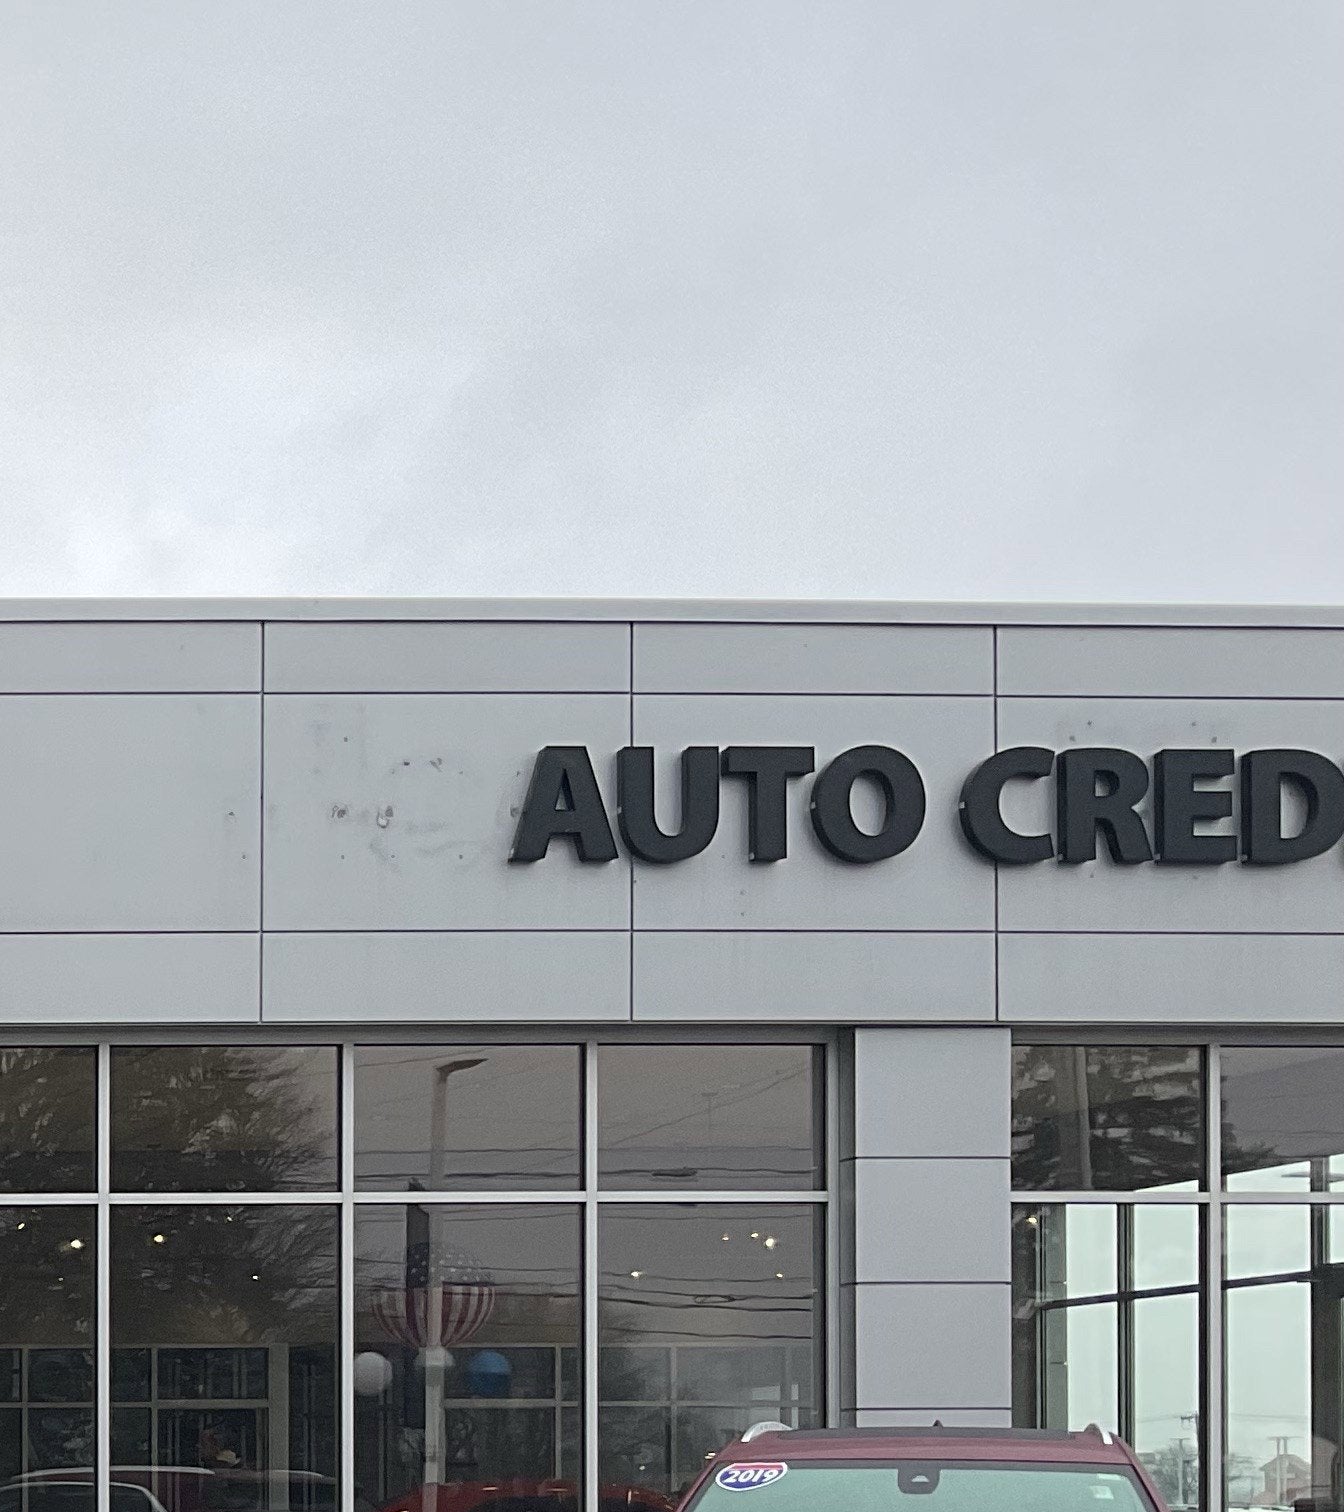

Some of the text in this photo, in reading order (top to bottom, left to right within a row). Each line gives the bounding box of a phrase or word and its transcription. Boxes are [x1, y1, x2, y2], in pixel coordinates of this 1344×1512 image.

[507, 744, 1344, 868] AUTO CRED
[722, 1469, 780, 1483] 2019
